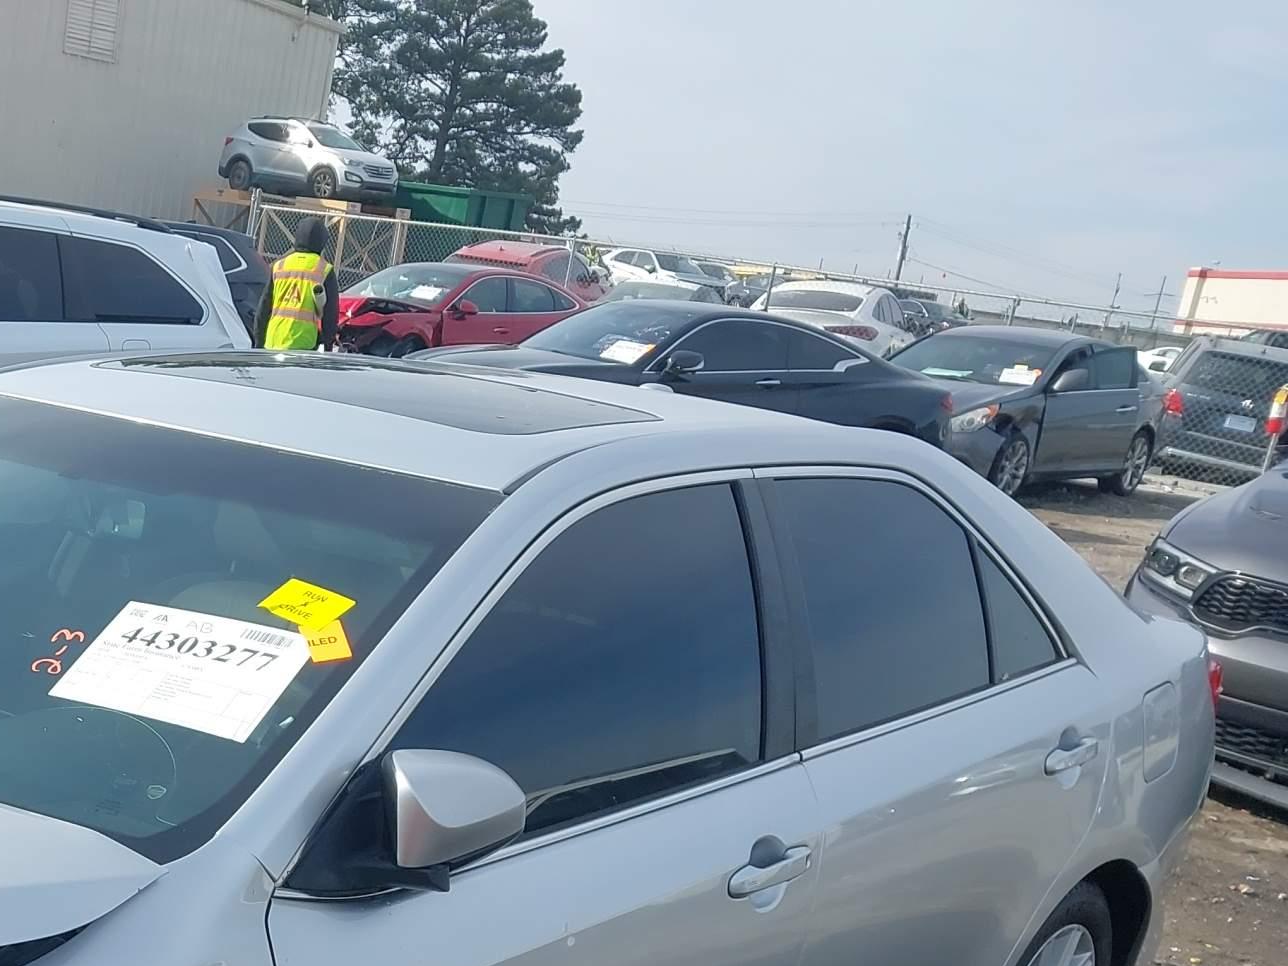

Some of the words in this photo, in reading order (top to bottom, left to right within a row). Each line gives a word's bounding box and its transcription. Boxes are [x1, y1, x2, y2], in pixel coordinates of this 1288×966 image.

[302, 590, 329, 603] RUN
[184, 620, 215, 634] AB
[31, 628, 85, 675] 2-3
[120, 626, 281, 672] 44303277
